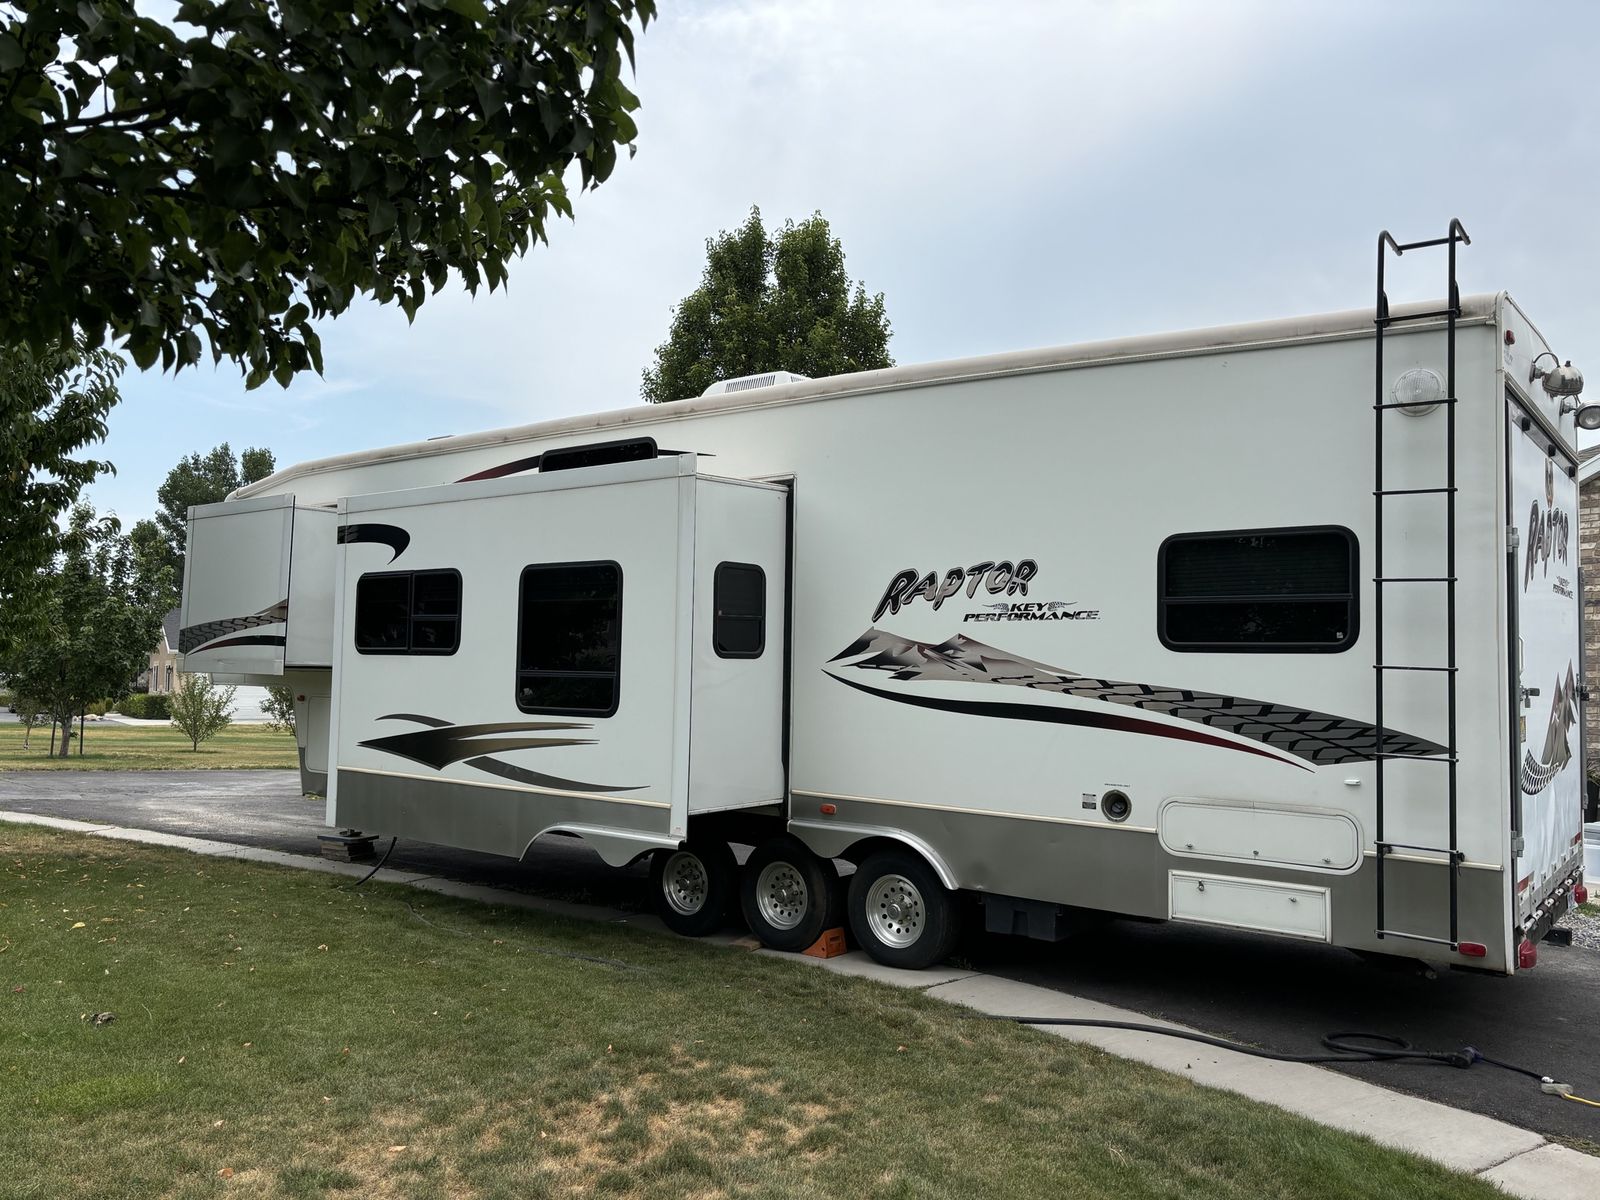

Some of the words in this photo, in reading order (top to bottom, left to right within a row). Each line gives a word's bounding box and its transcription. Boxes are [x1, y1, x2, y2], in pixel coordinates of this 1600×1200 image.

[1524, 499, 1569, 594] RAPTOR
[872, 559, 1039, 623] RAPTOR
[1009, 602, 1049, 612] KEY
[963, 610, 1100, 622] PERFORMANCE
